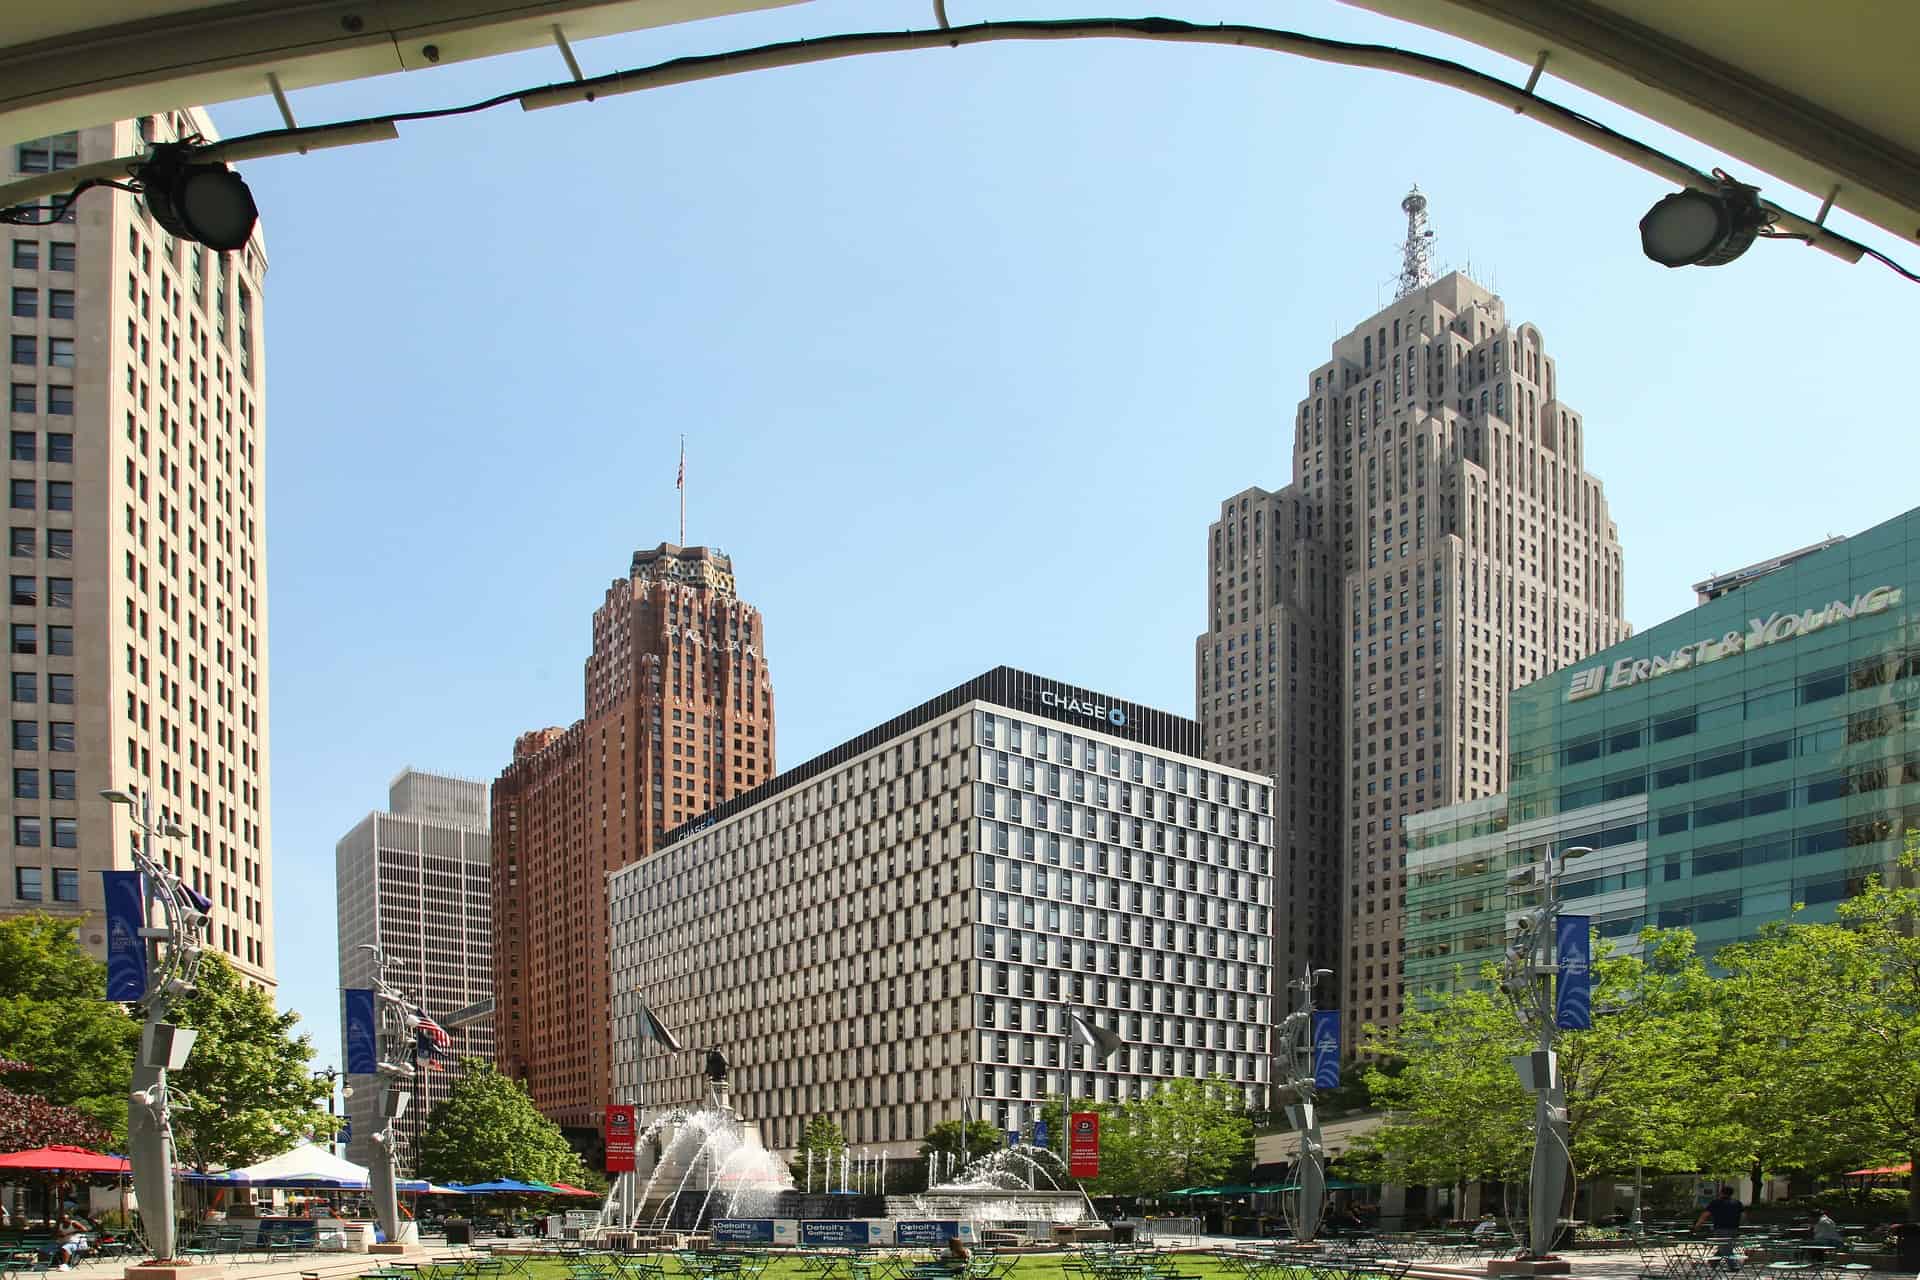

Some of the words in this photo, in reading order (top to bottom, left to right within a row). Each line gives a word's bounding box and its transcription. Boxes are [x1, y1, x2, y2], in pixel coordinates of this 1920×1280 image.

[1608, 637, 1716, 690] ERNST
[1719, 630, 1746, 656] &
[1748, 585, 1903, 646] YOUNG
[1041, 691, 1106, 720] CHASE
